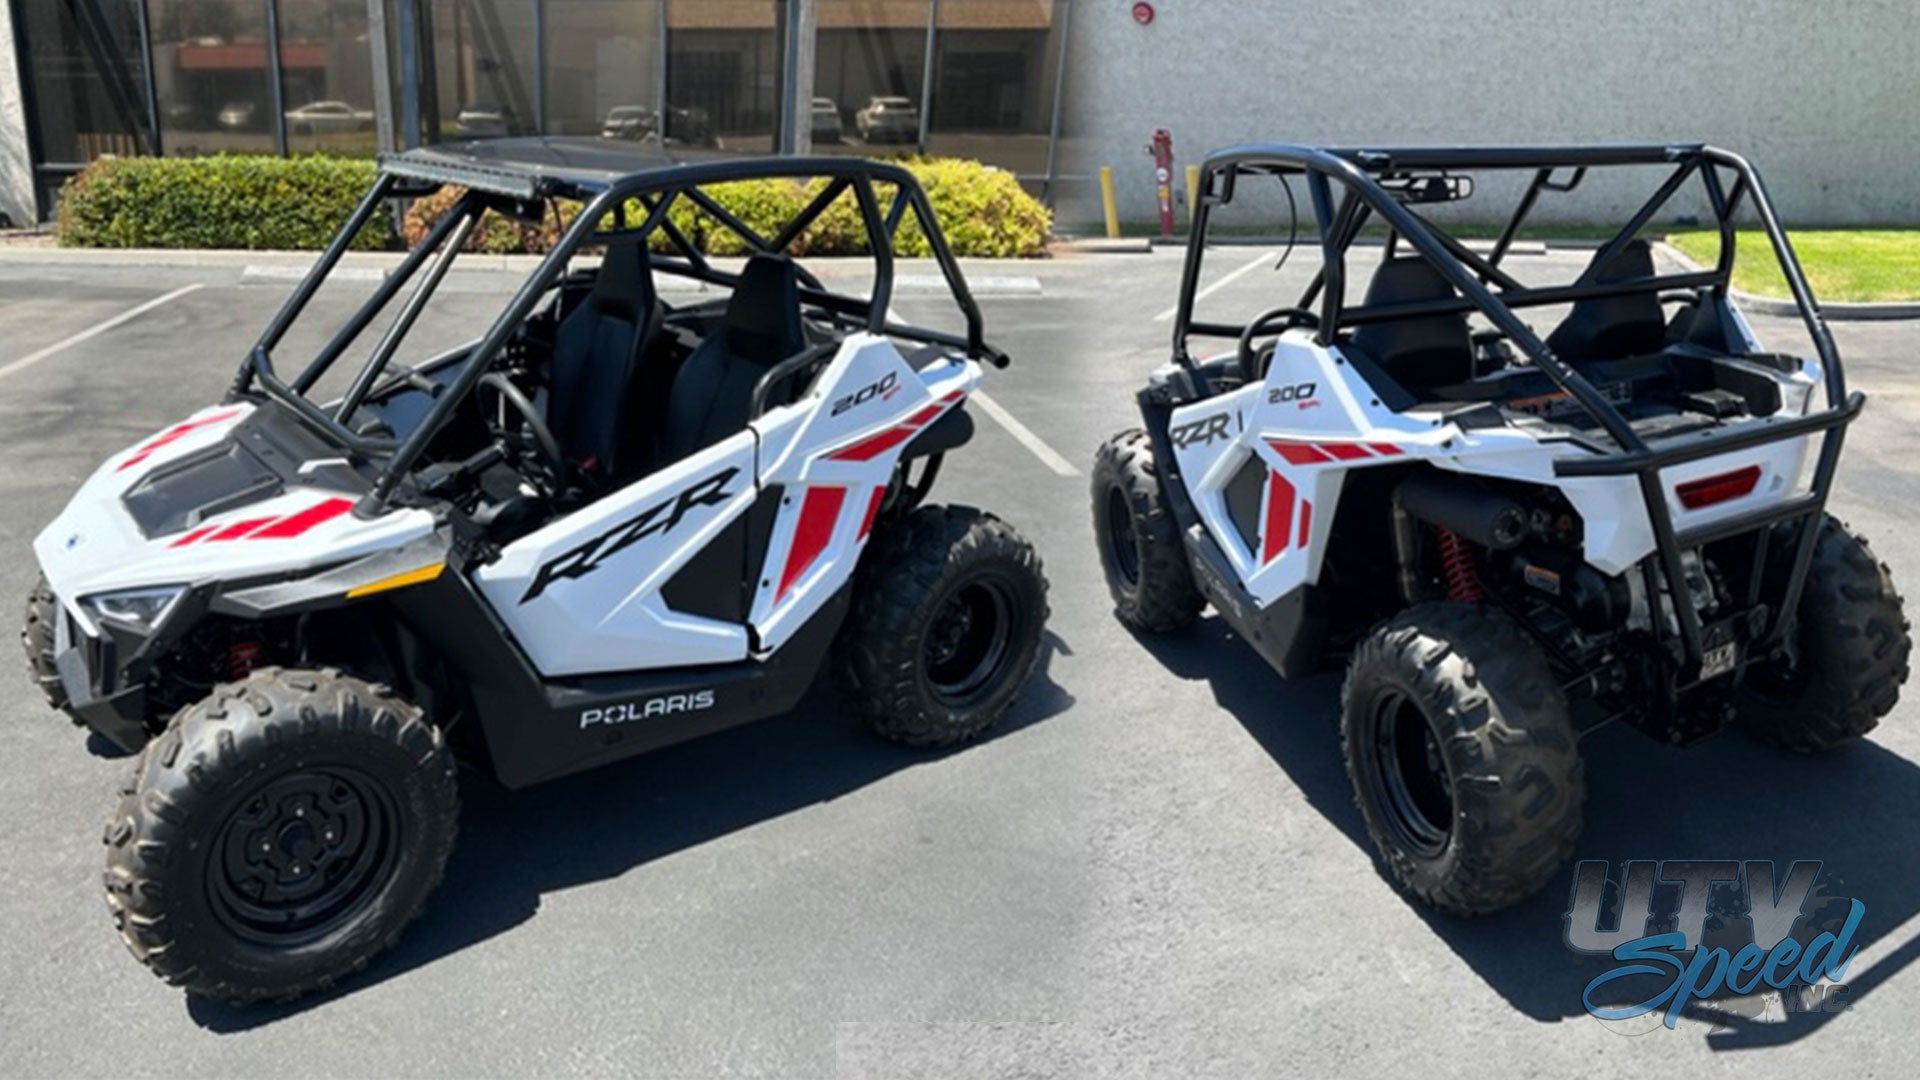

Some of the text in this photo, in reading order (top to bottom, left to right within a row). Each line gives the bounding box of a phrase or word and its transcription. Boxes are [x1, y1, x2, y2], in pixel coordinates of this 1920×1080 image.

[831, 370, 897, 417] 200
[1268, 383, 1316, 404] 200
[518, 466, 741, 607] RZR
[579, 690, 715, 729] POLARIS
